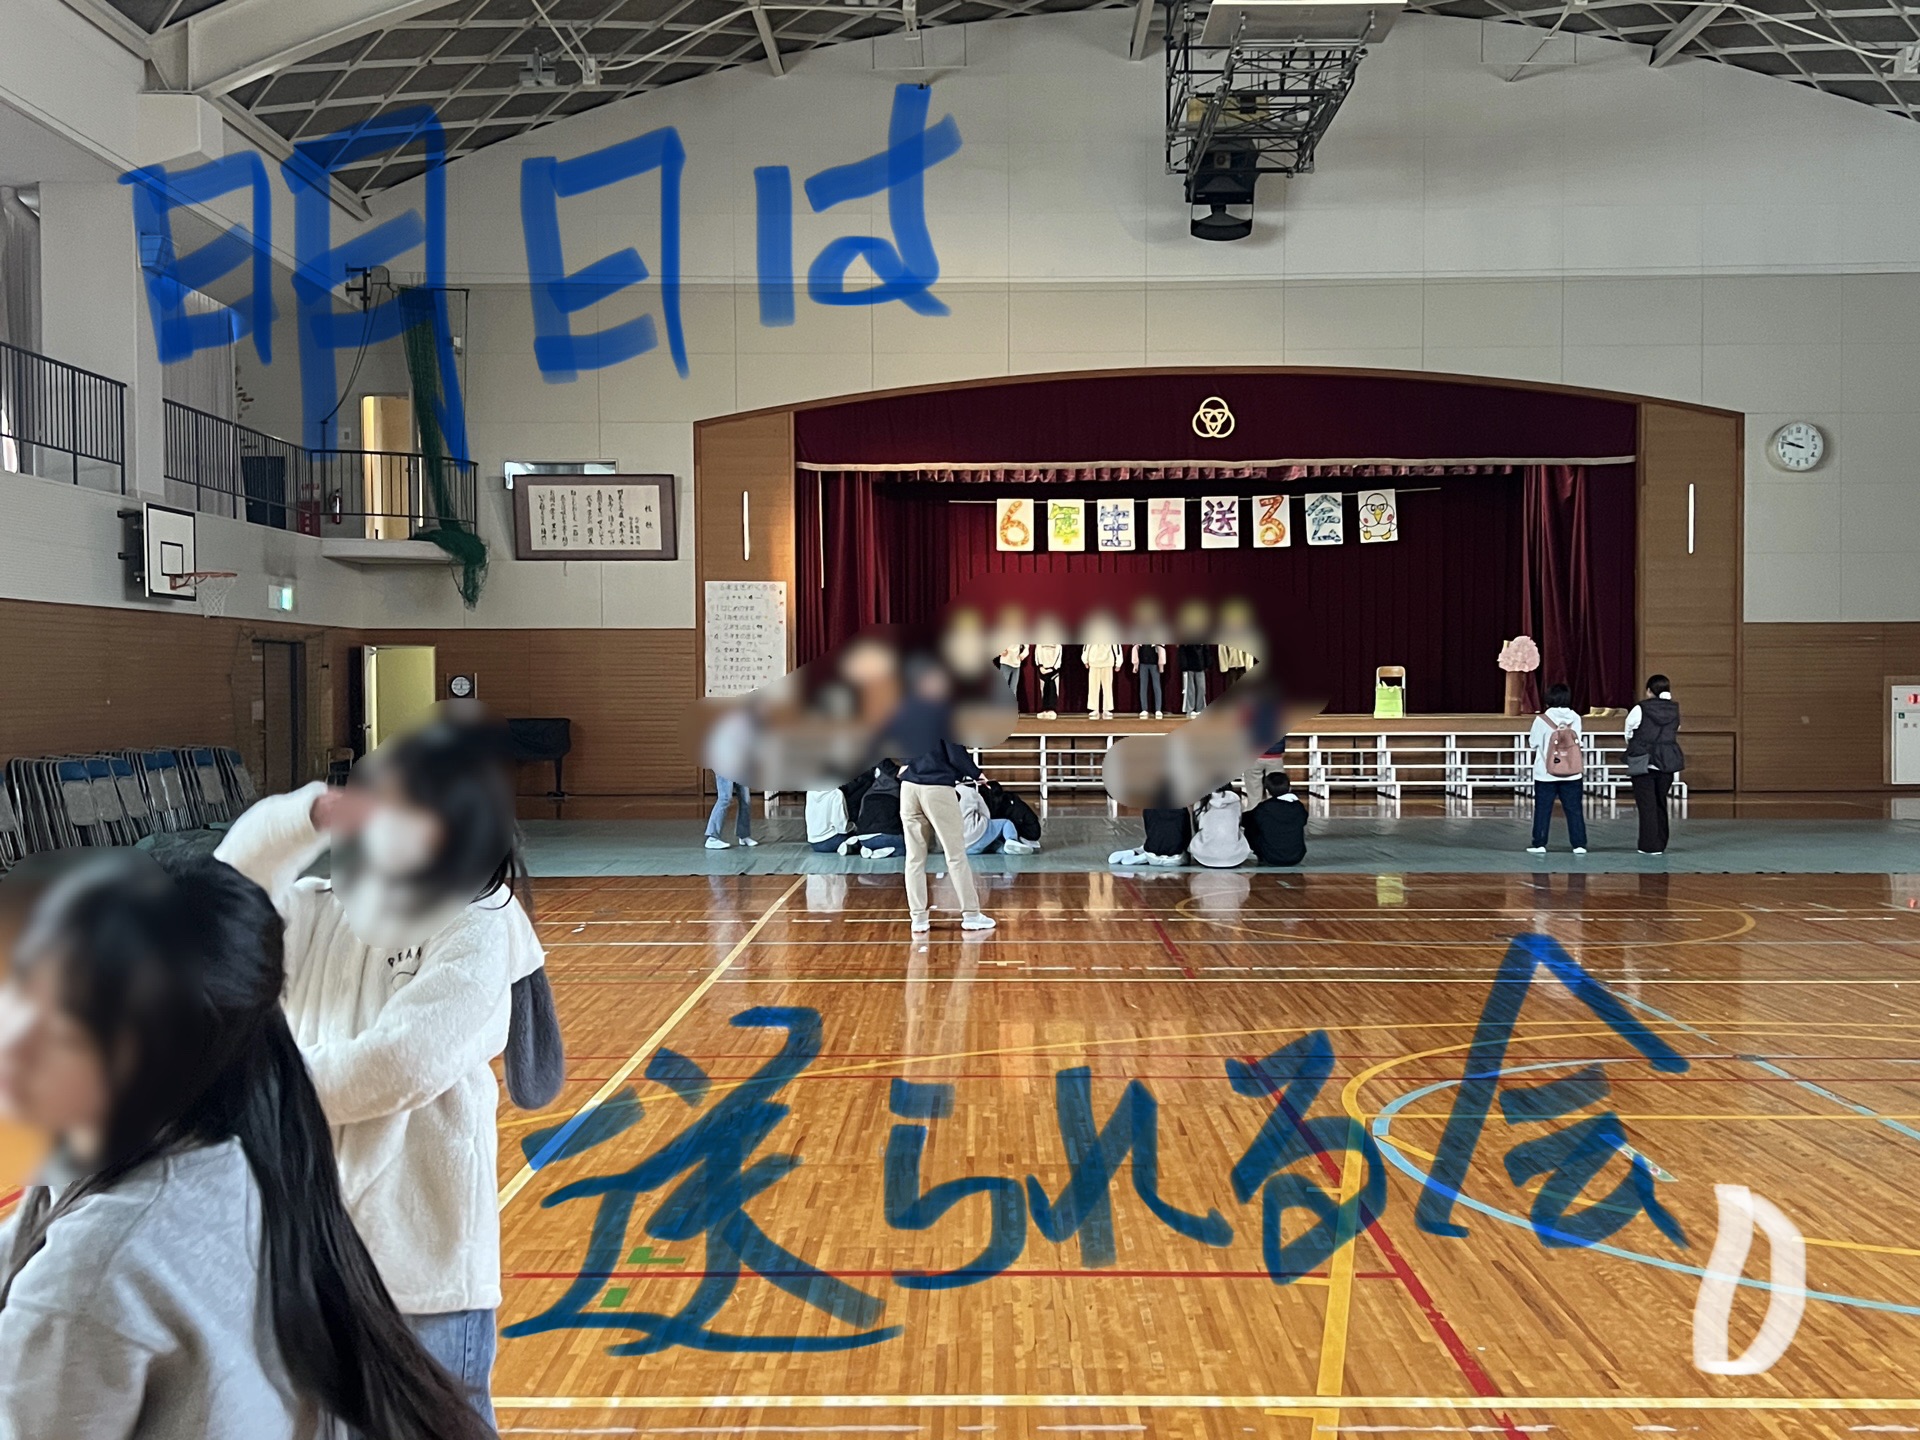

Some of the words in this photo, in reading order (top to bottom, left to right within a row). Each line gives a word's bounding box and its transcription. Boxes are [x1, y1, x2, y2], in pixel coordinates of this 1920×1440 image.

[999, 493, 1343, 550] 6年生を送る会
